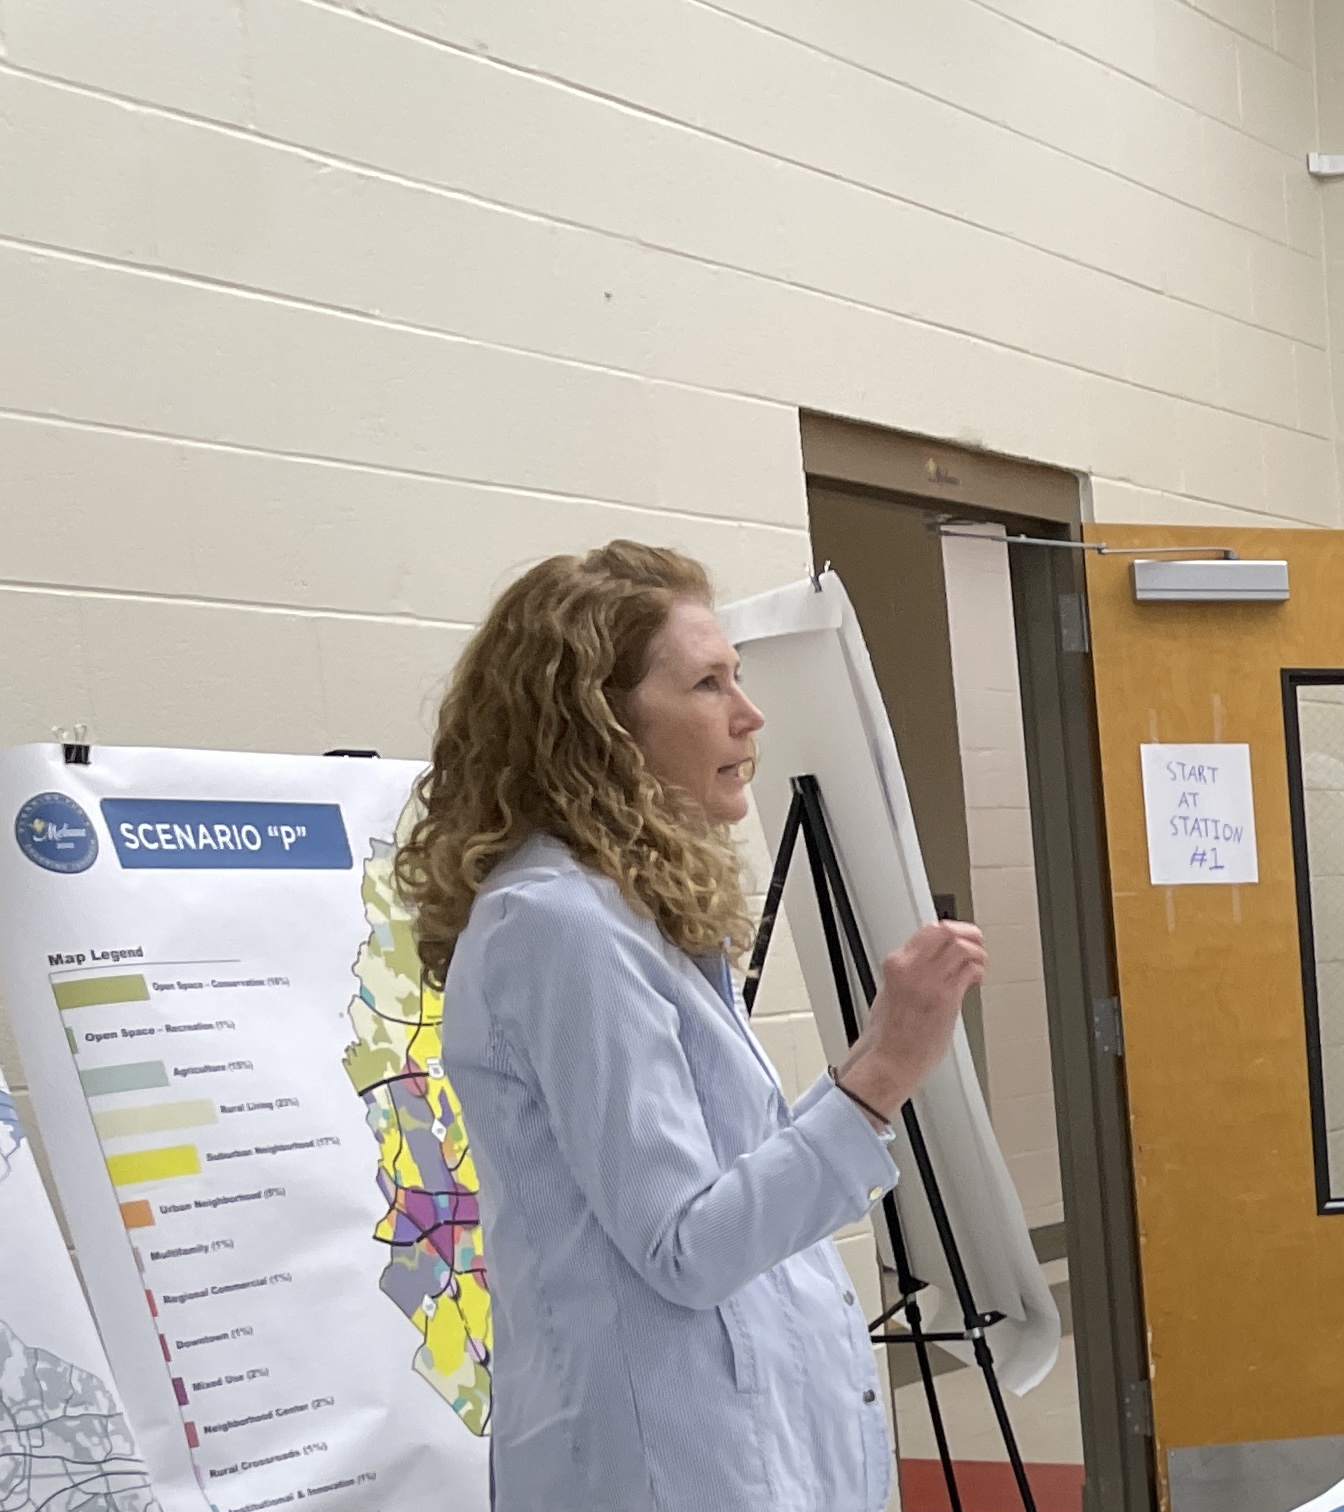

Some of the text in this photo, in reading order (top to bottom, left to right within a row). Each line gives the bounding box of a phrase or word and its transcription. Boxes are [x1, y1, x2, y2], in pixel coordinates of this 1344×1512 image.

[1166, 760, 1219, 784] START
[1178, 791, 1199, 808] AT
[120, 822, 262, 851] SCENARIO
[1170, 814, 1244, 843] STATION
[1190, 846, 1225, 870] #1
[48, 946, 143, 966] Map Legend
[85, 1031, 118, 1043] Open
[121, 1027, 155, 1039] Space
[203, 1410, 274, 1435] Neighborhood
[275, 1403, 310, 1418] Center
[209, 1464, 238, 1478] Rural
[241, 1449, 300, 1471] Crossroads
